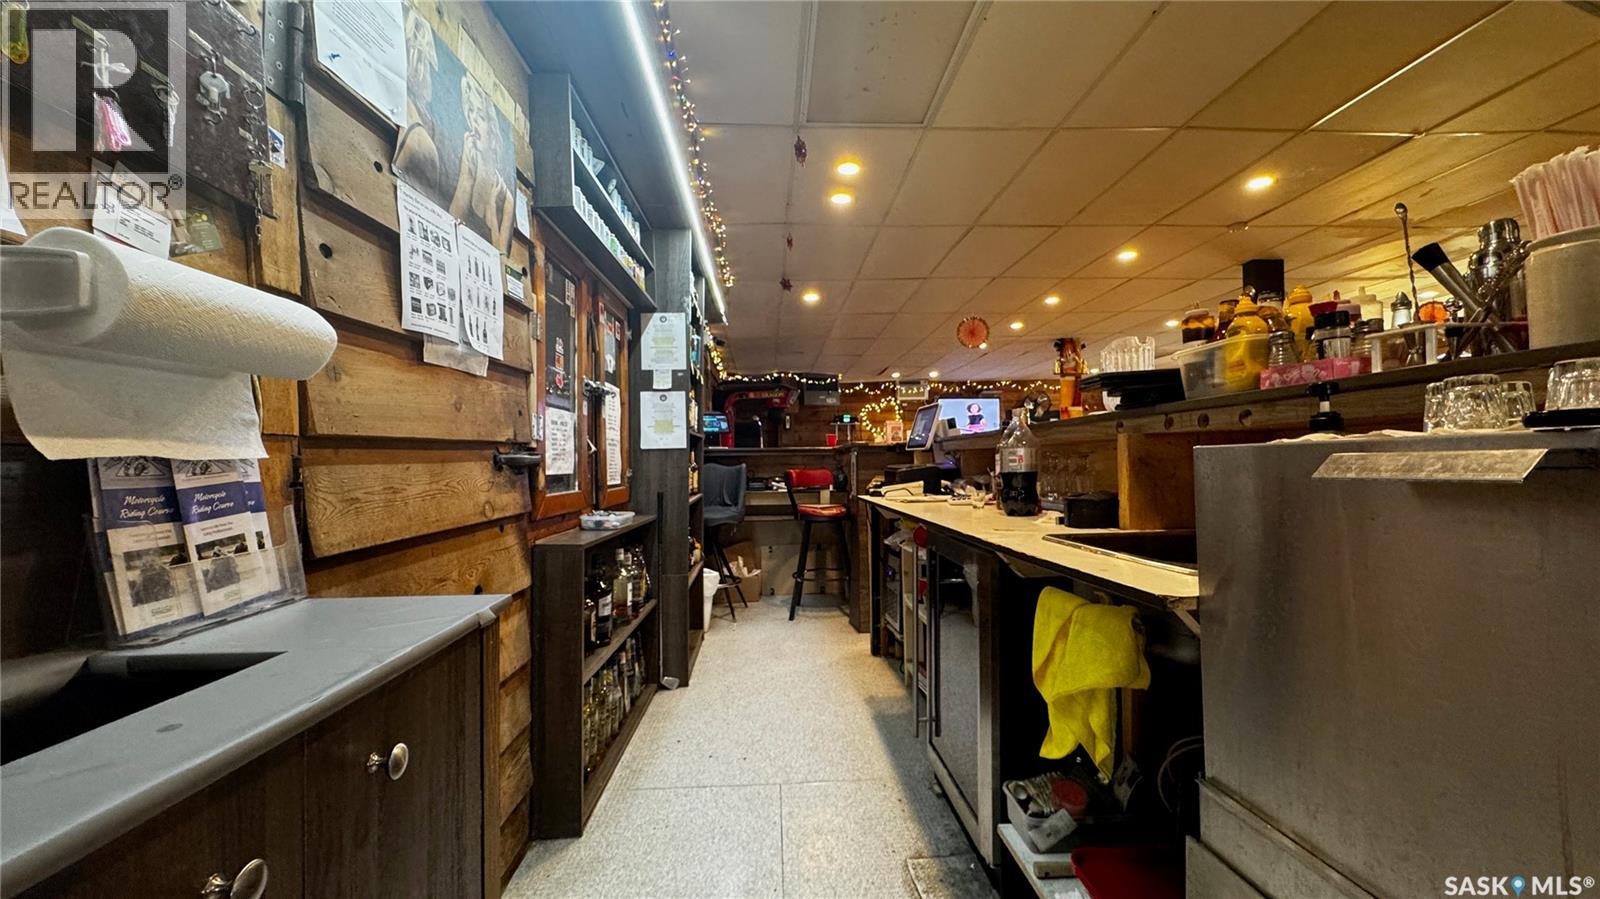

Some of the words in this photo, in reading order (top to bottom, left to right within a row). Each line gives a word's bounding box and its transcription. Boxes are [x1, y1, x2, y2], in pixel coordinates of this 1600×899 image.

[123, 494, 166, 506] Motorcycle
[192, 490, 226, 502] Motorcycle
[119, 508, 146, 519] Riding
[191, 504, 212, 515] Riding
[212, 501, 234, 511] Course
